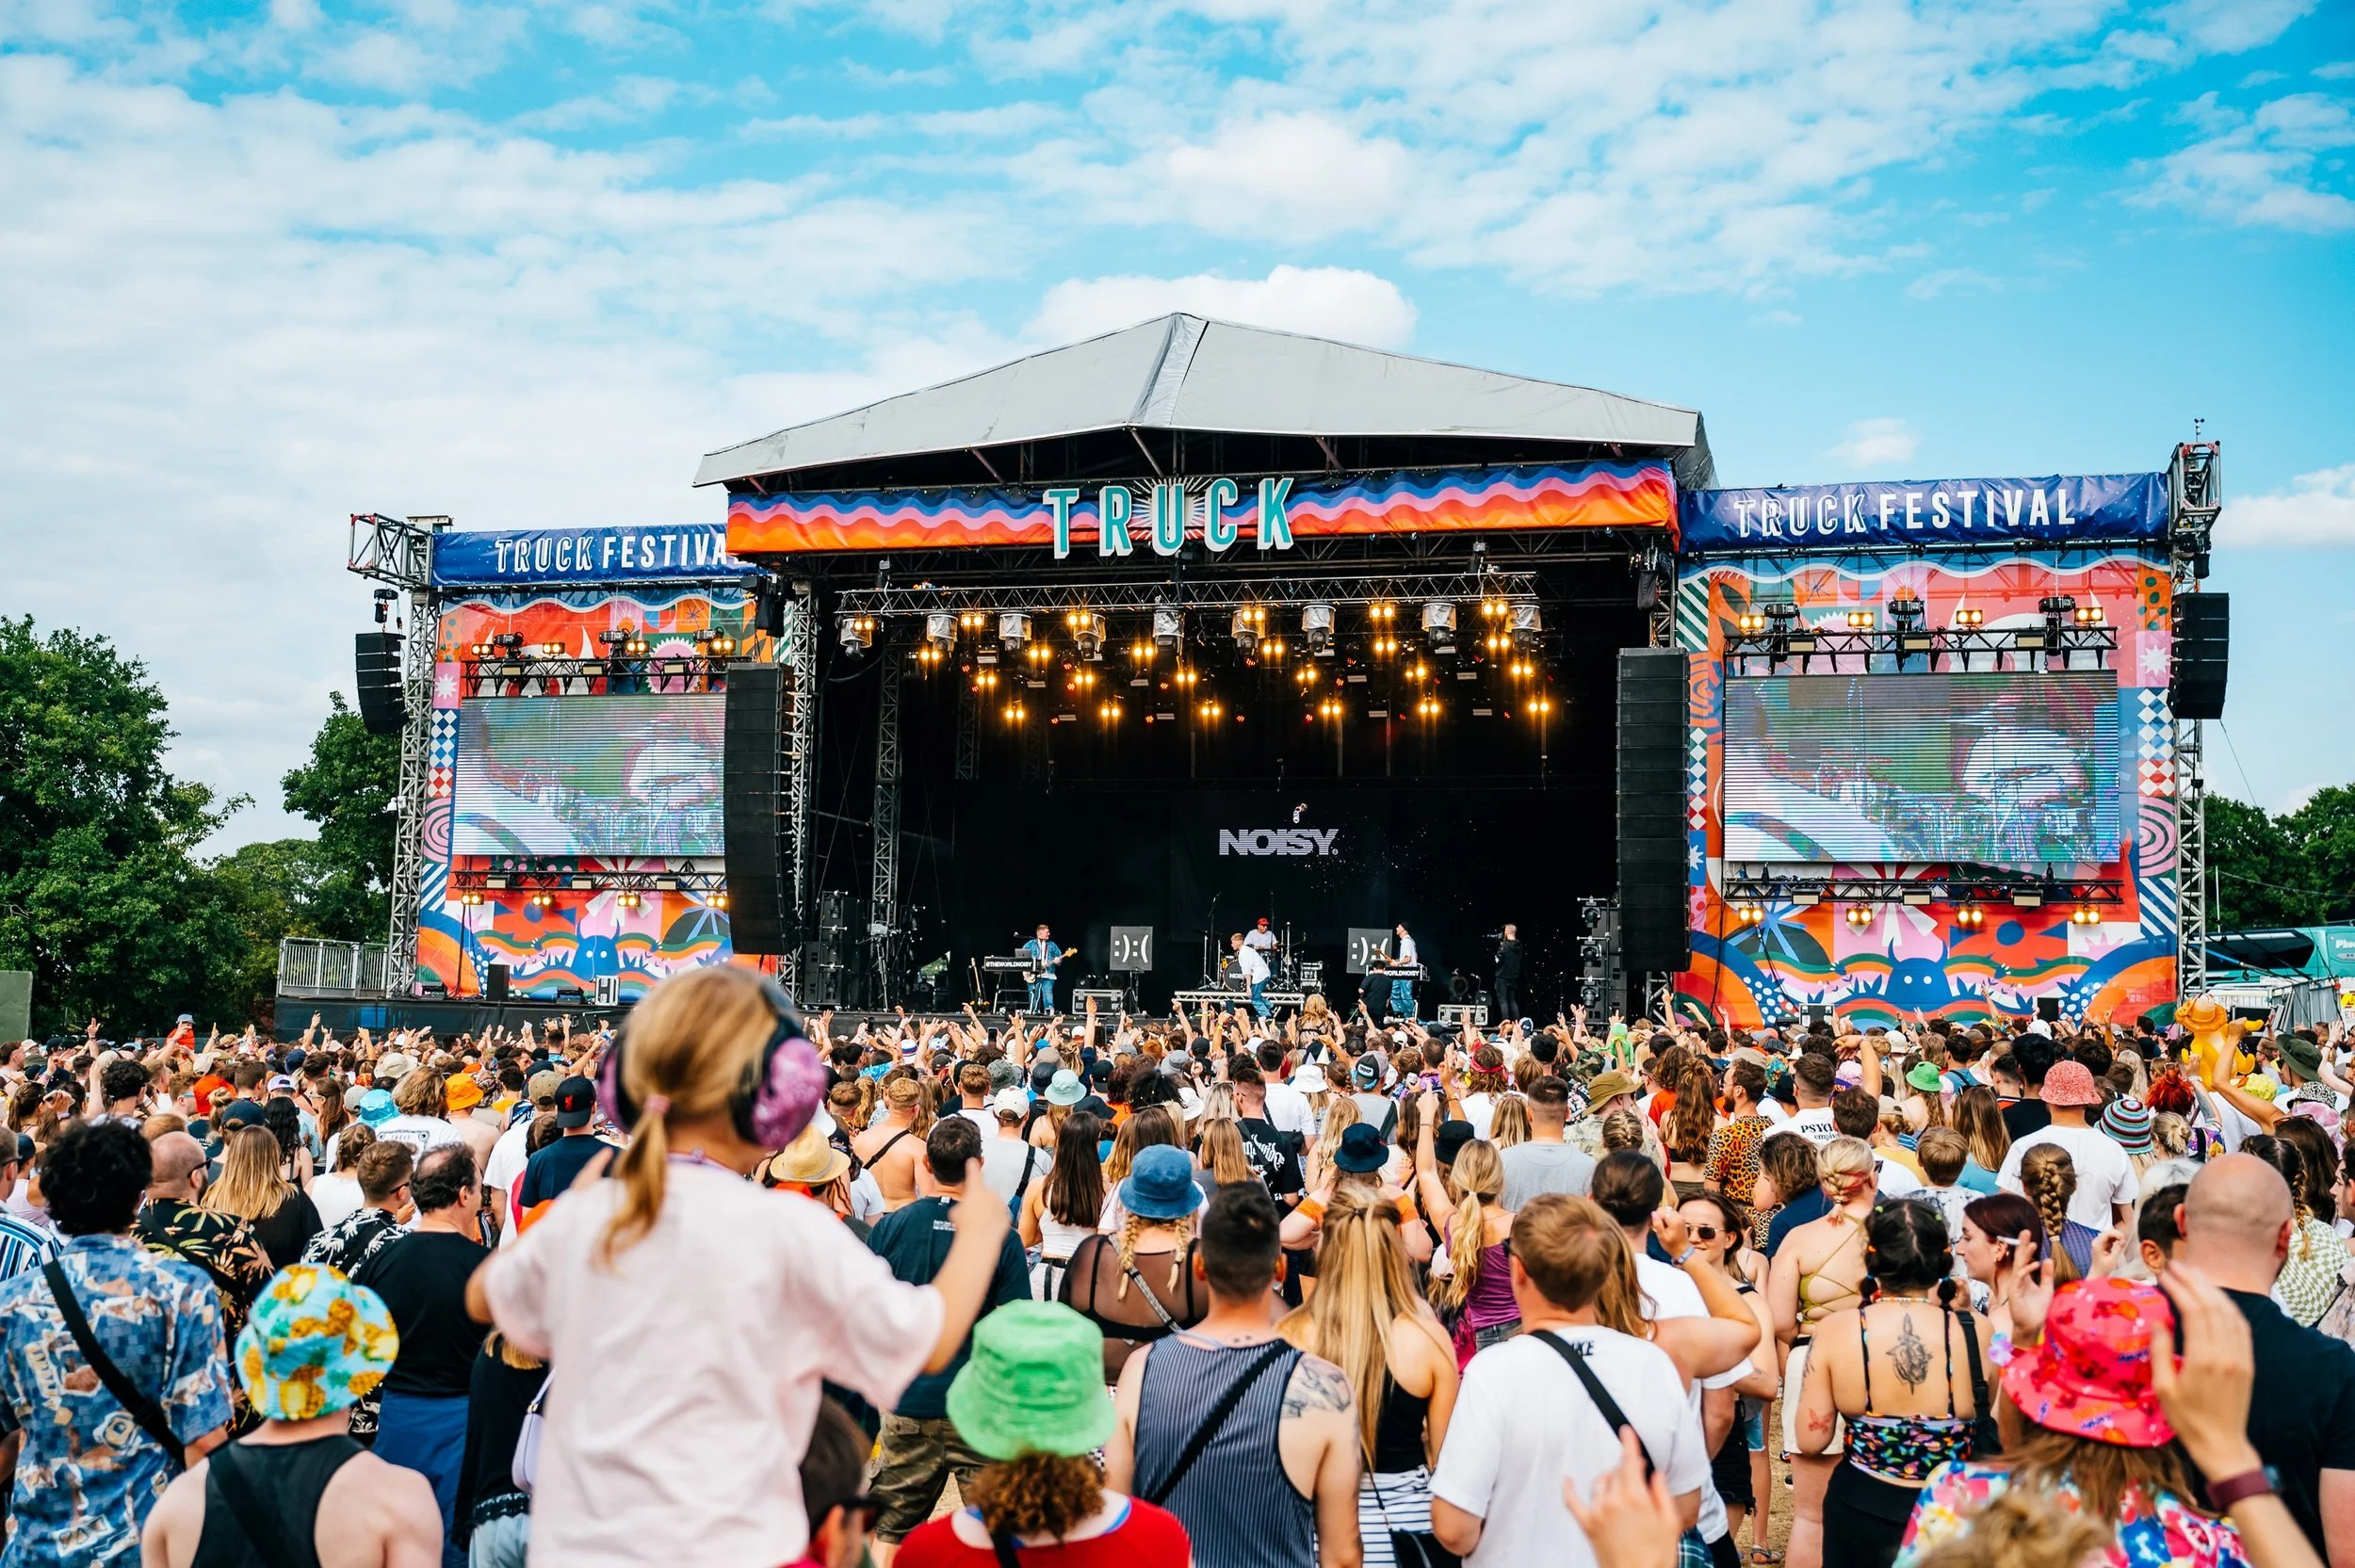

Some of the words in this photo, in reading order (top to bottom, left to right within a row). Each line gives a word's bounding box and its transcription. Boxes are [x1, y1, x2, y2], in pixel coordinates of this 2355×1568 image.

[1043, 477, 1294, 558] TRUCK
[1733, 493, 1866, 538] TRUCK
[1879, 488, 2076, 529] FESTIVAL
[495, 536, 593, 573] TRUCK
[602, 532, 756, 569] FESTIVA
[1219, 829, 1339, 856] NOISY
